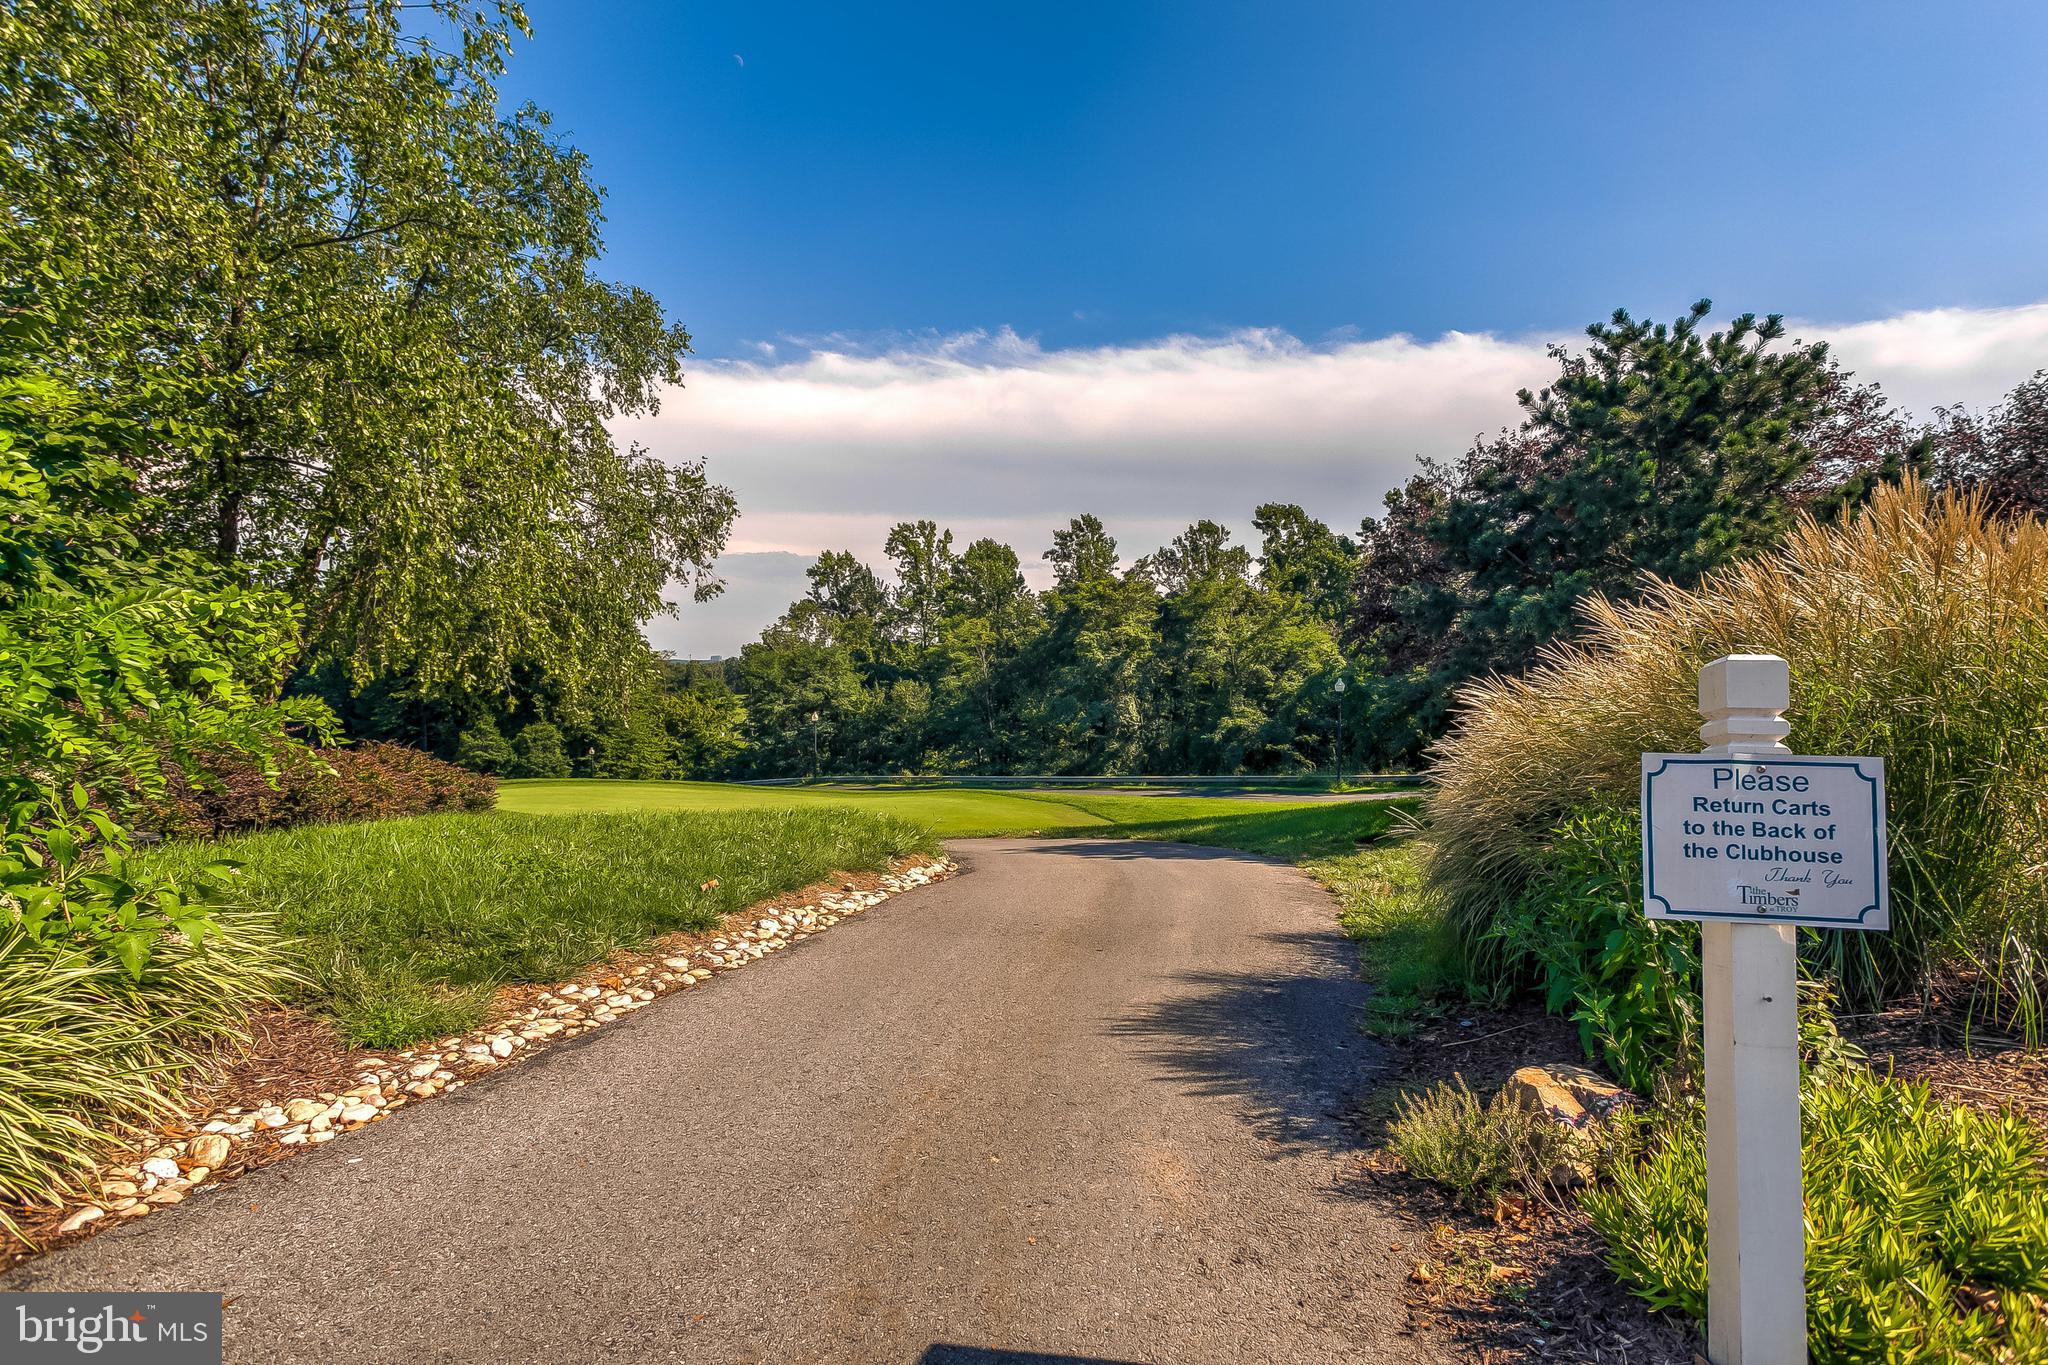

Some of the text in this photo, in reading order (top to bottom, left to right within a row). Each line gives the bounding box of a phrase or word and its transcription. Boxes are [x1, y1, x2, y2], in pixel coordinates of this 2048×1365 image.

[1714, 768, 1809, 792] Please
[1693, 797, 1831, 816] Return Carts
[1683, 820, 1836, 840] to the Back of
[1683, 843, 1843, 864] the Clubhouse
[1765, 867, 1854, 888] Thank You
[1737, 885, 1798, 907] Timbers
[1752, 886, 1766, 895] the
